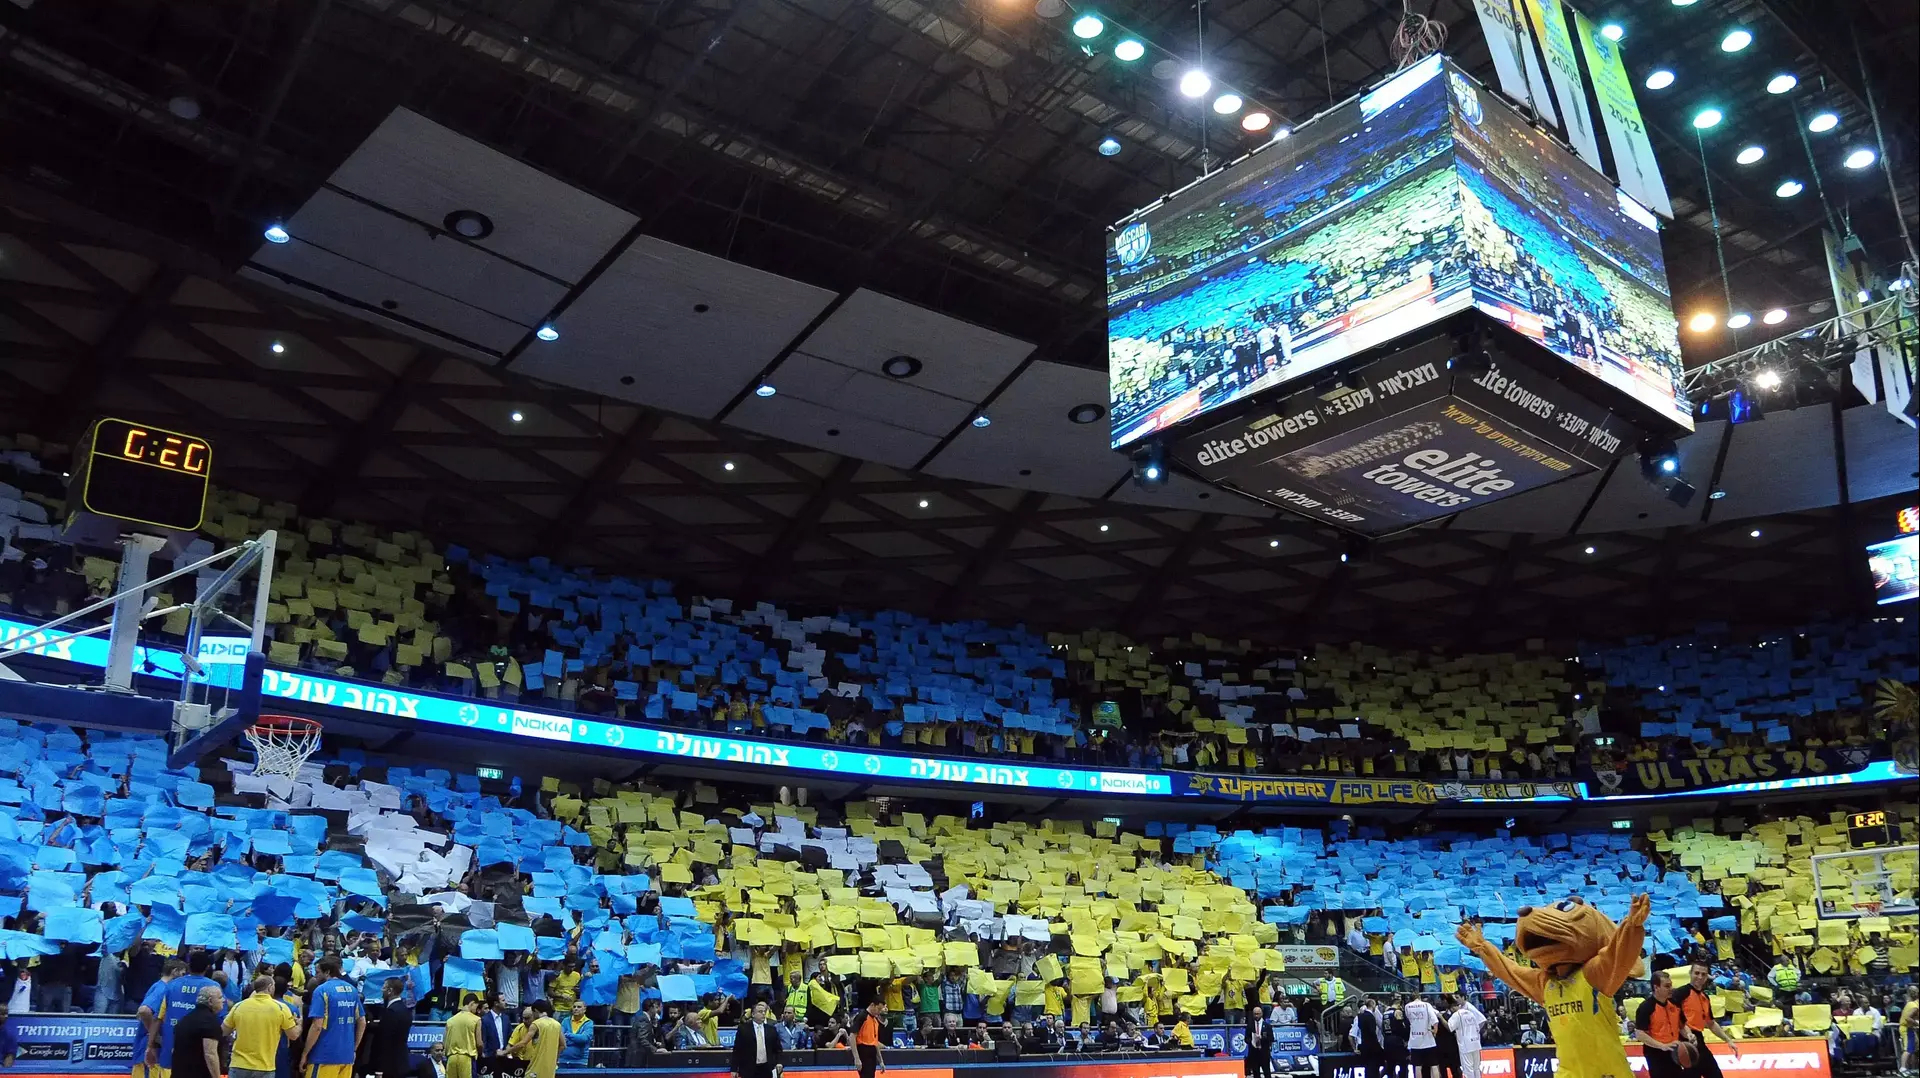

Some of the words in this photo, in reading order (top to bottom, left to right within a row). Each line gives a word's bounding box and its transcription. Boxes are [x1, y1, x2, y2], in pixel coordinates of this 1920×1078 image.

[1551, 55, 1581, 89] 2005
[1608, 103, 1641, 134] 2012
[1114, 222, 1147, 250] MACCABI
[1503, 379, 1555, 419] towers
[1197, 435, 1248, 467] elite
[1243, 409, 1319, 450] towers
[1361, 462, 1473, 507] towers
[1402, 449, 1516, 496] elite
[261, 668, 337, 706] עולה
[341, 686, 420, 719] צהוב
[514, 716, 570, 734] NOKIA
[656, 731, 721, 759] עולה
[727, 741, 790, 766] צהוב
[910, 758, 969, 781] עולה
[973, 766, 1030, 786] צהוב
[1635, 755, 1779, 790] ULTRAS
[1783, 750, 1829, 774] 96
[1101, 777, 1146, 789] NOKIA
[1217, 777, 1328, 801] SUPPORTERS
[1340, 783, 1374, 802] FOR
[1377, 783, 1413, 802] LIFE
[1548, 1000, 1584, 1017] ELECTRA
[16, 1025, 82, 1036] ובאנדרואיד
[84, 1025, 124, 1039] באייפון
[28, 1047, 53, 1058] Google
[54, 1048, 69, 1057] play
[97, 1049, 114, 1059] App
[114, 1049, 134, 1058] Store
[1525, 1057, 1548, 1078] feel
